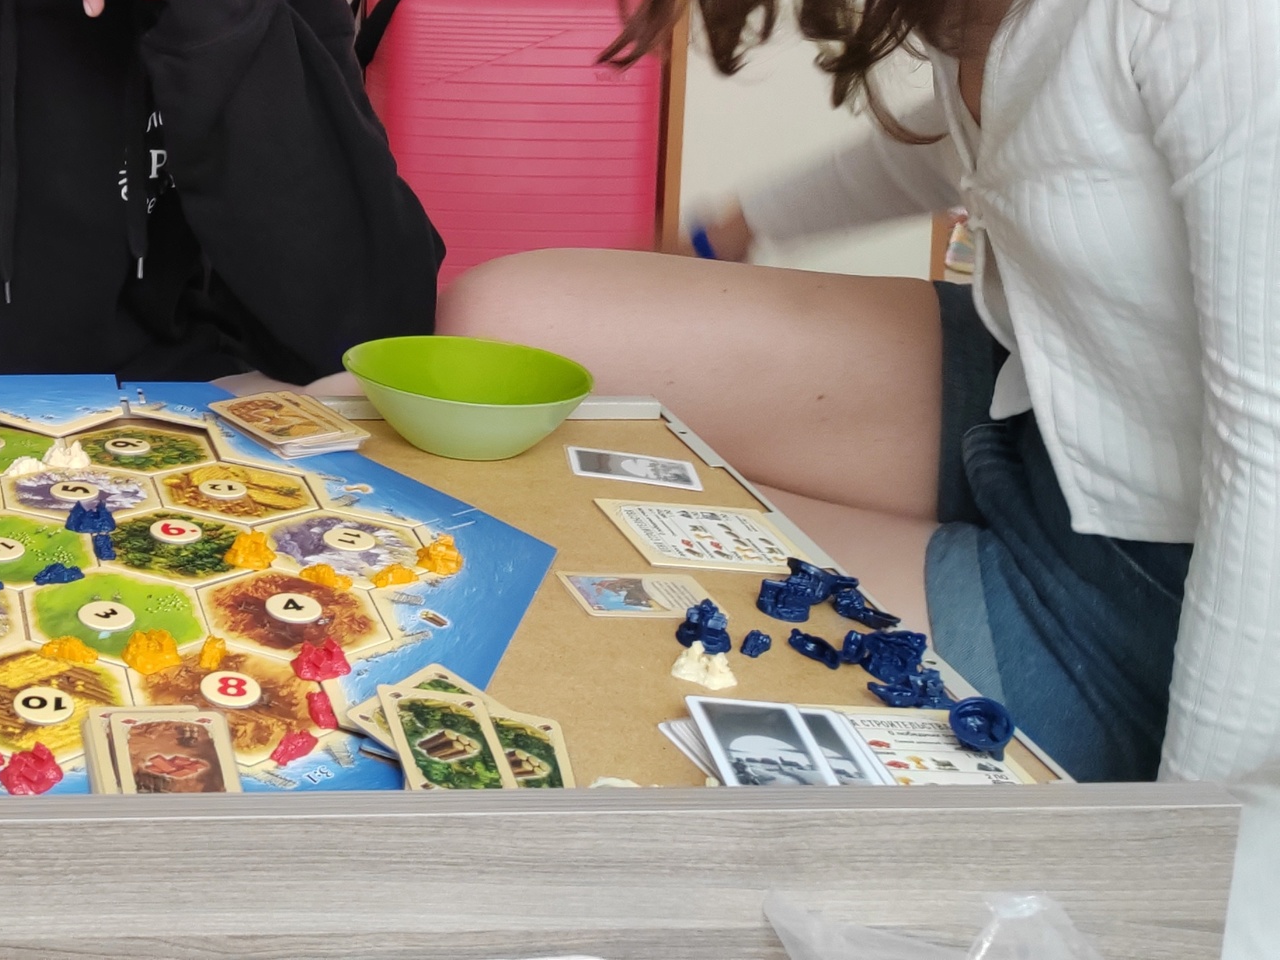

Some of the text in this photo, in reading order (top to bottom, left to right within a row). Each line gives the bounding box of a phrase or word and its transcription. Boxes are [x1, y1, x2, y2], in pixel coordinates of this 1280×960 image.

[282, 598, 306, 611] 4
[217, 676, 247, 697] 8
[21, 695, 67, 712] 10
